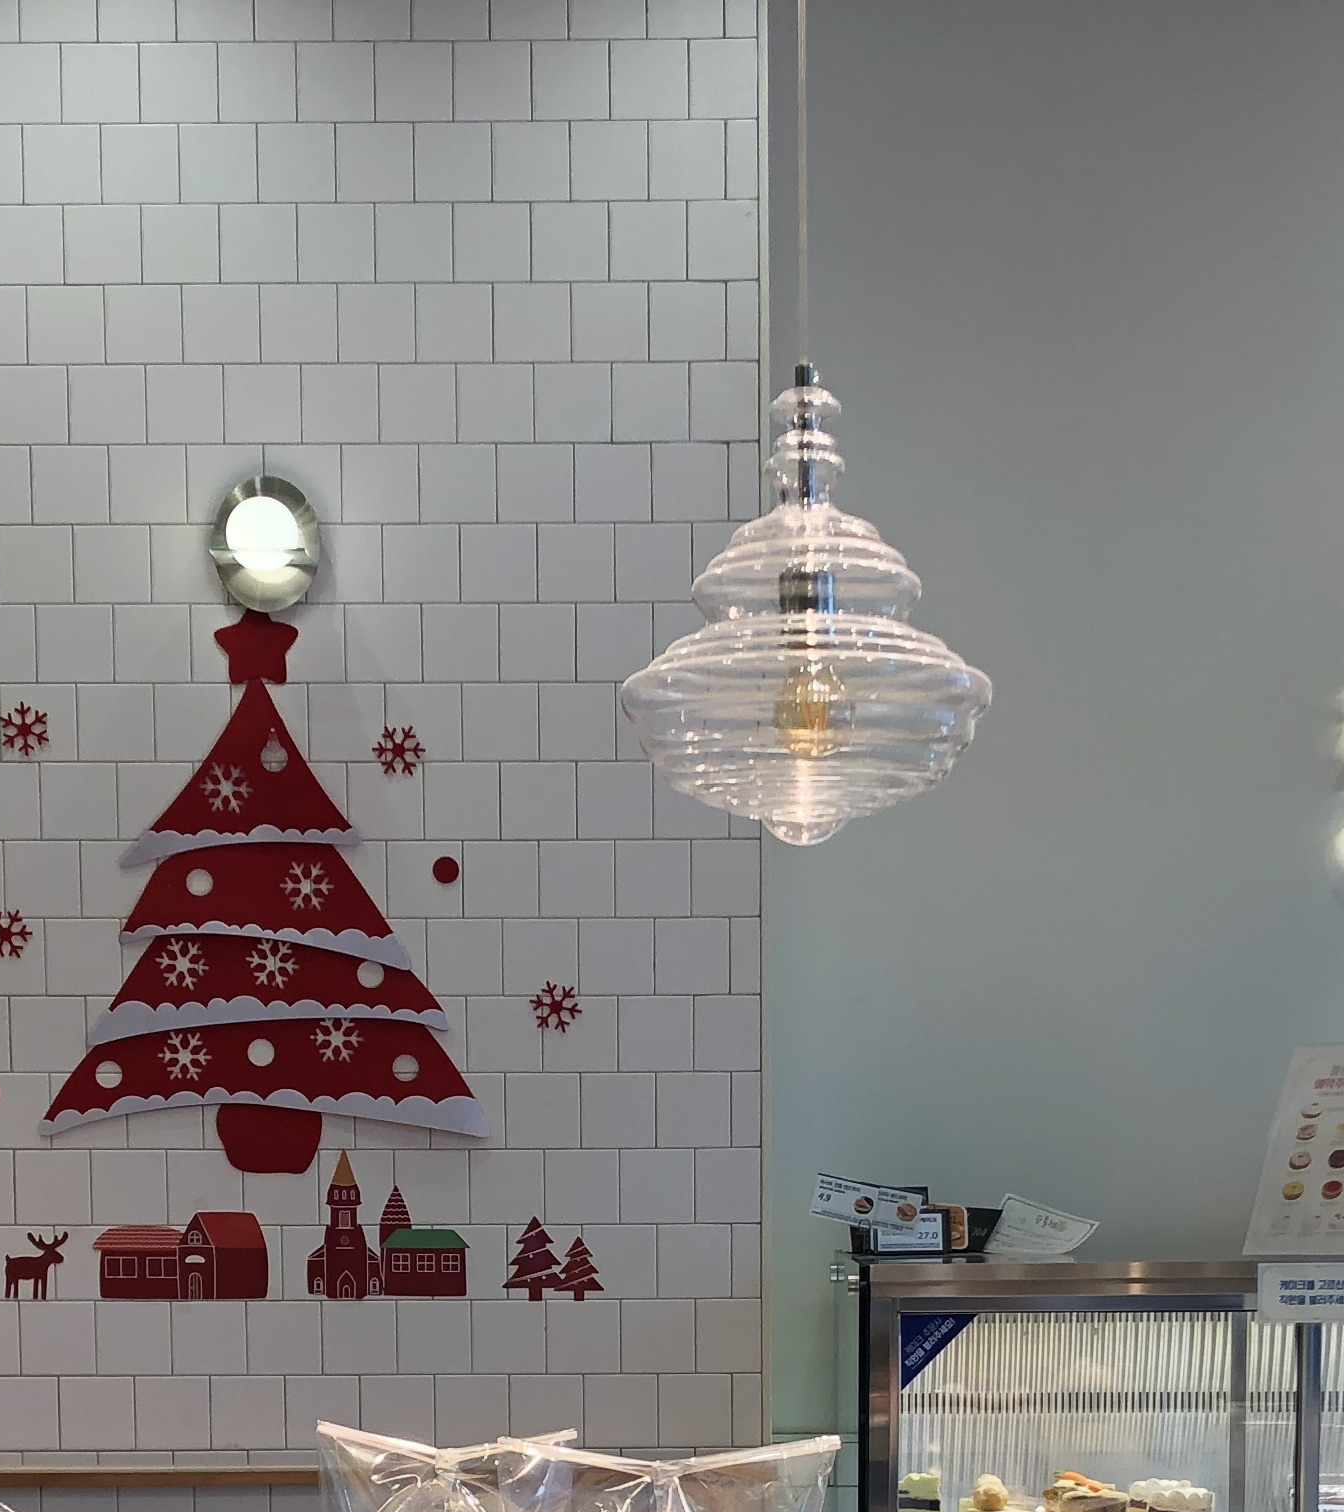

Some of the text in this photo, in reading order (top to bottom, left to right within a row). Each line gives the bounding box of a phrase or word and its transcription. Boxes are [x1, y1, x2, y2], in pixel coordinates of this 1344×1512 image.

[917, 1231, 938, 1240] 27.0
[1280, 1280, 1315, 1290] 케이크를
[1279, 1295, 1306, 1305] 직원을
